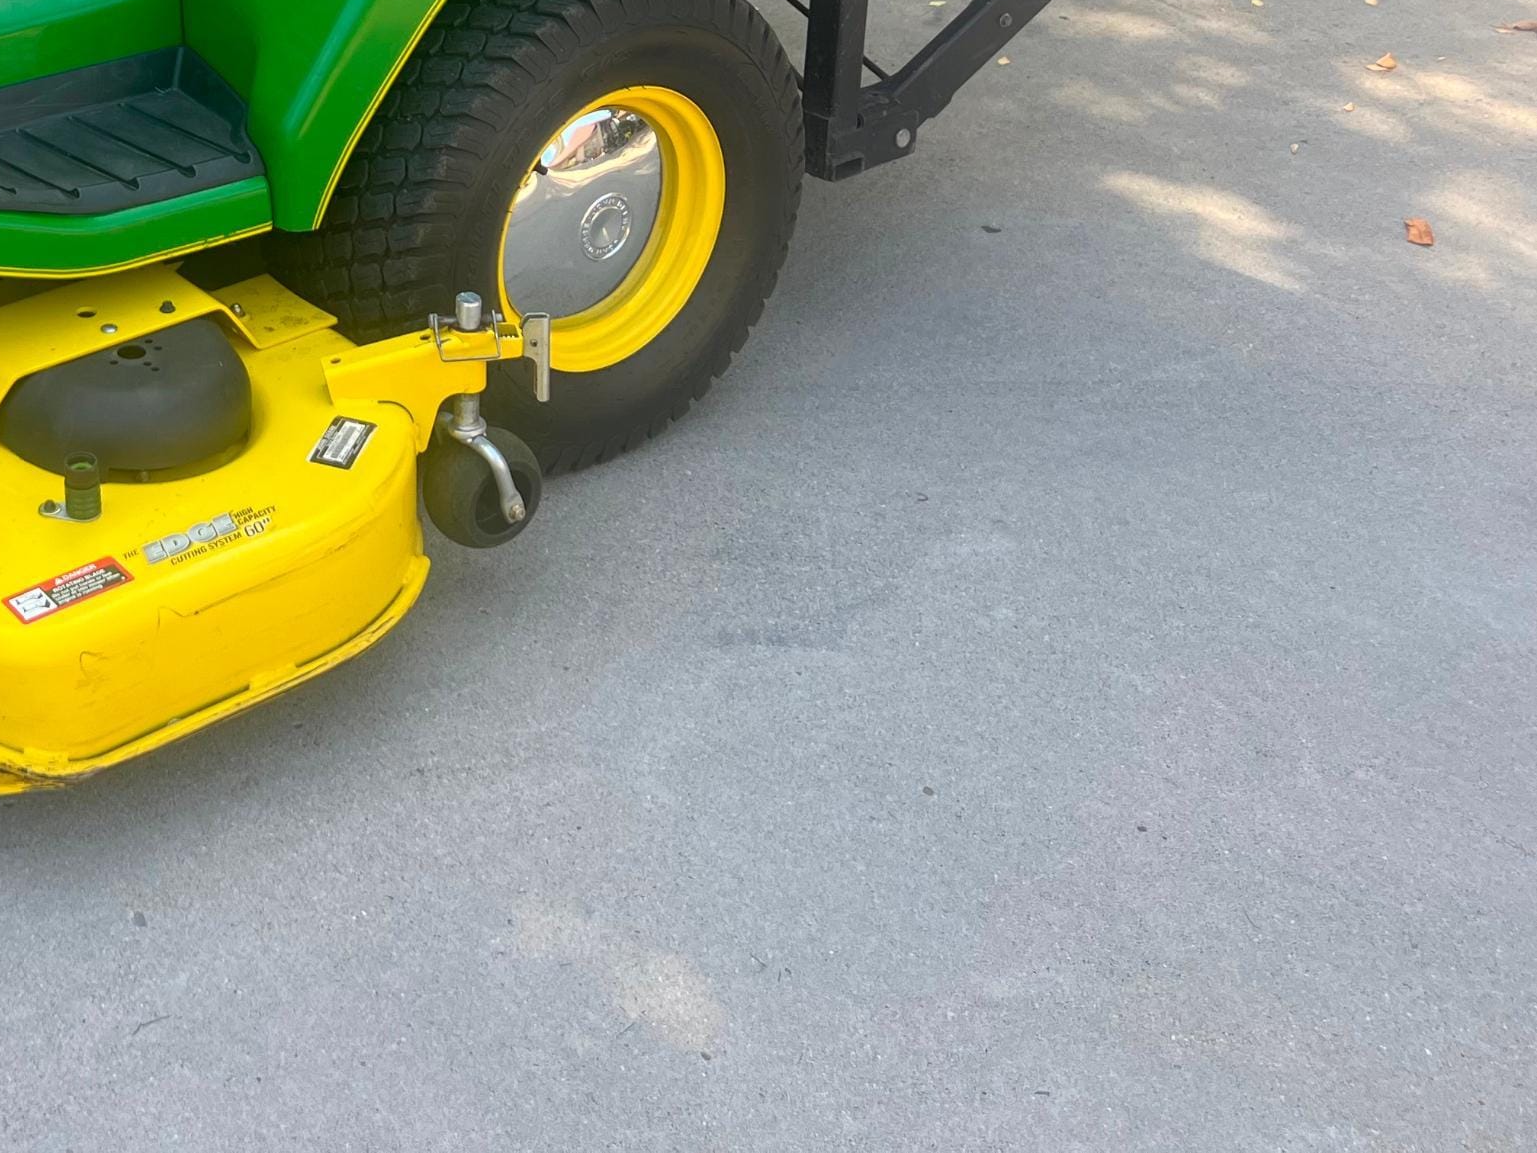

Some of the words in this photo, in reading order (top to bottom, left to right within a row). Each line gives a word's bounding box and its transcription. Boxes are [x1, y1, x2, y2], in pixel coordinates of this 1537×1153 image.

[234, 507, 253, 519] HIGH
[238, 505, 276, 525] CAPACITY
[123, 549, 139, 560] THE
[143, 511, 238, 564] EDGE
[170, 545, 207, 565] CUTTING
[208, 532, 242, 550] SYSTEM
[244, 518, 270, 538] 60"
[61, 564, 97, 581] DANGER
